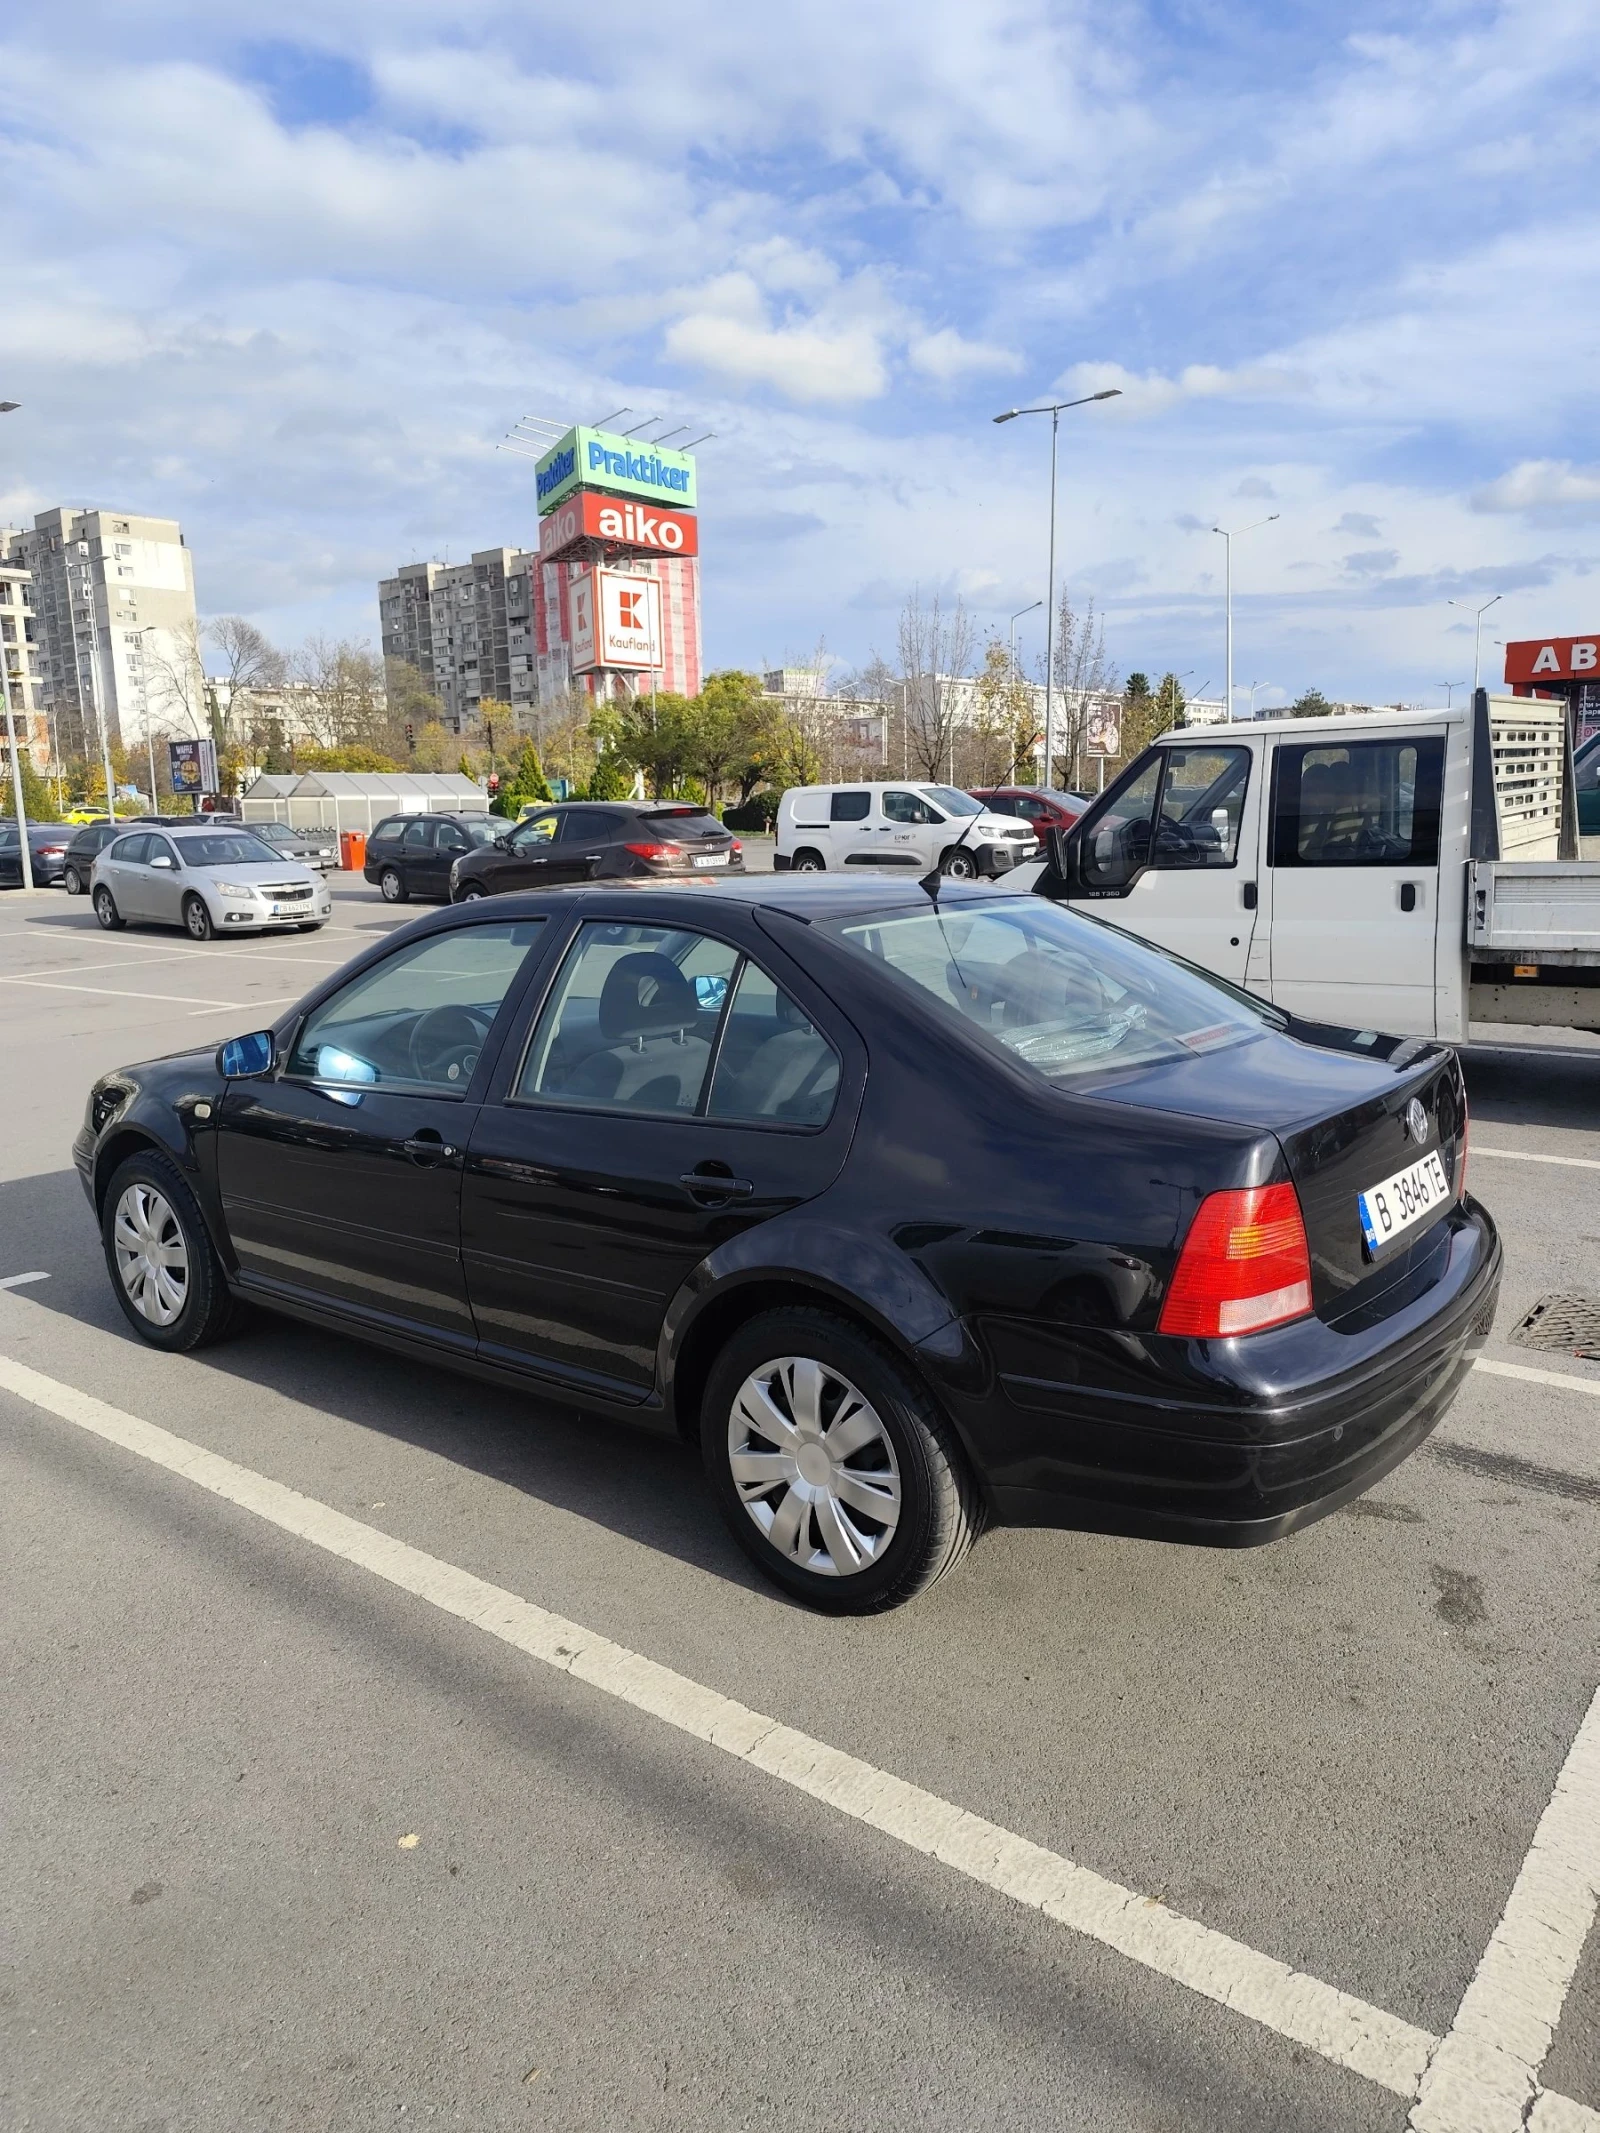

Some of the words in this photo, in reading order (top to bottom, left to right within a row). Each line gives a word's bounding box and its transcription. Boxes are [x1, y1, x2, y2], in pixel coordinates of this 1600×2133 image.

[536, 447, 575, 501] Praktiker
[588, 441, 690, 492] Praktiker
[544, 511, 576, 554] aiko
[599, 504, 684, 550] aiko
[609, 634, 656, 652] Kaufland
[1375, 1192, 1392, 1233] B
[1393, 1167, 1430, 1220] 3846
[1423, 1156, 1446, 1197] TE
